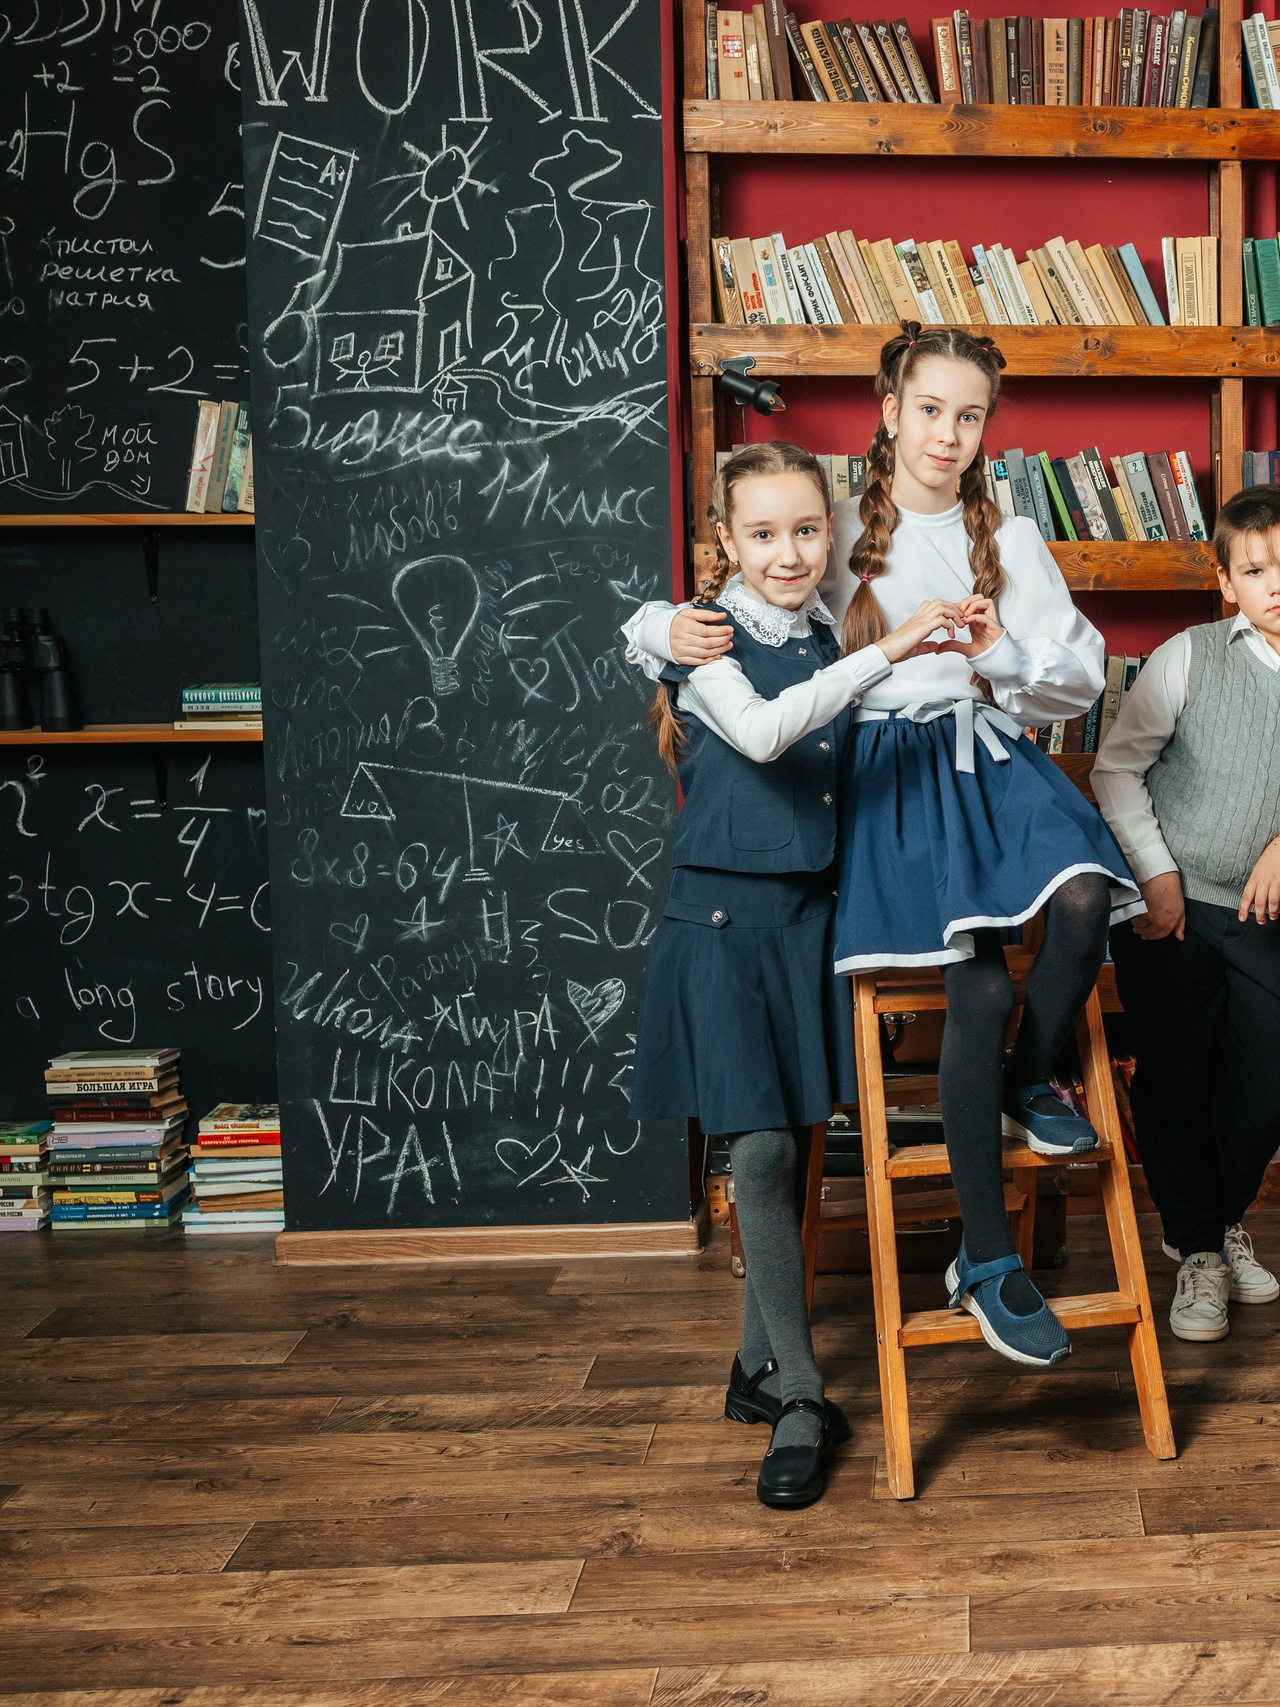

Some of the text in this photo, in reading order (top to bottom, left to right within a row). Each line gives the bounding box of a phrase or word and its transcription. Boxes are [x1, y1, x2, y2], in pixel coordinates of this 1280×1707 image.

[242, 0, 662, 123] WORK
[797, 263, 815, 298] ФОРСАЙТ
[64, 967, 136, 1043] long
[160, 961, 263, 1030] story
[76, 1081, 155, 1093] БОЛЬШАЯ ИГРА
